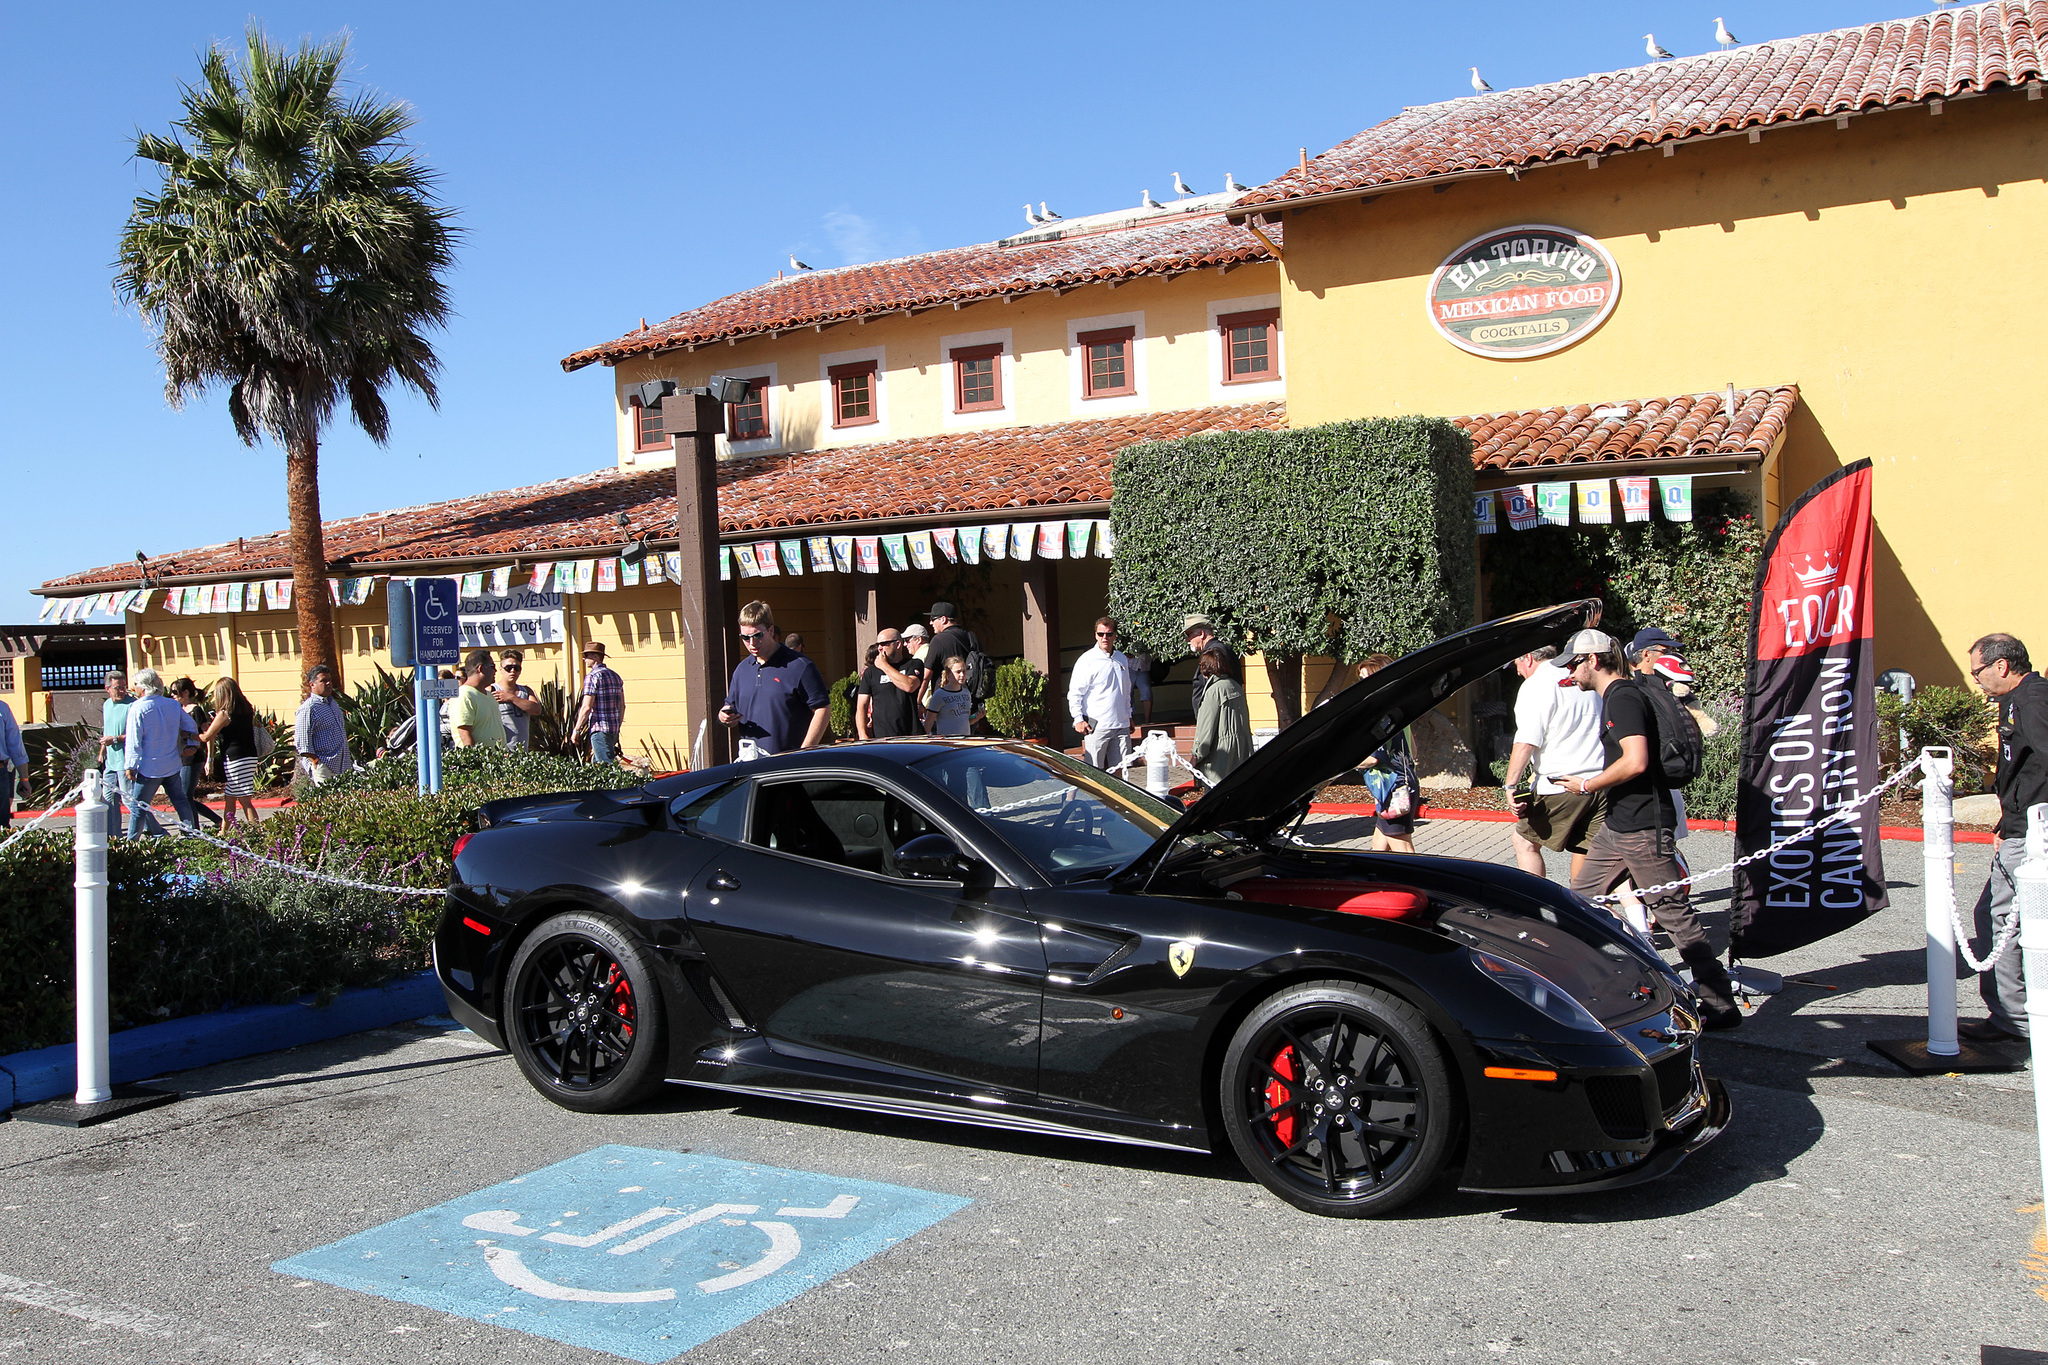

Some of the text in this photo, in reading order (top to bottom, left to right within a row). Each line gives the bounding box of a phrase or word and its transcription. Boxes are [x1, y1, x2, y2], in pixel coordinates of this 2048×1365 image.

[1447, 238, 1597, 292] EL TORITO
[1439, 286, 1605, 319] MEXICAN FOOD
[1480, 321, 1561, 340] COCKTAILS
[516, 590, 562, 611] MENU
[502, 615, 543, 636] Long!
[1777, 584, 1854, 648] EOCR
[422, 625, 453, 635] RESERVED
[432, 637, 444, 647] FOR
[419, 649, 458, 659] HANDICAPPED
[422, 688, 458, 698] ACCESSIBLE
[1820, 658, 1863, 909] CANNERY ROW
[1766, 713, 1815, 908] EXOTICS ON
[575, 921, 619, 948] MICHELIN
